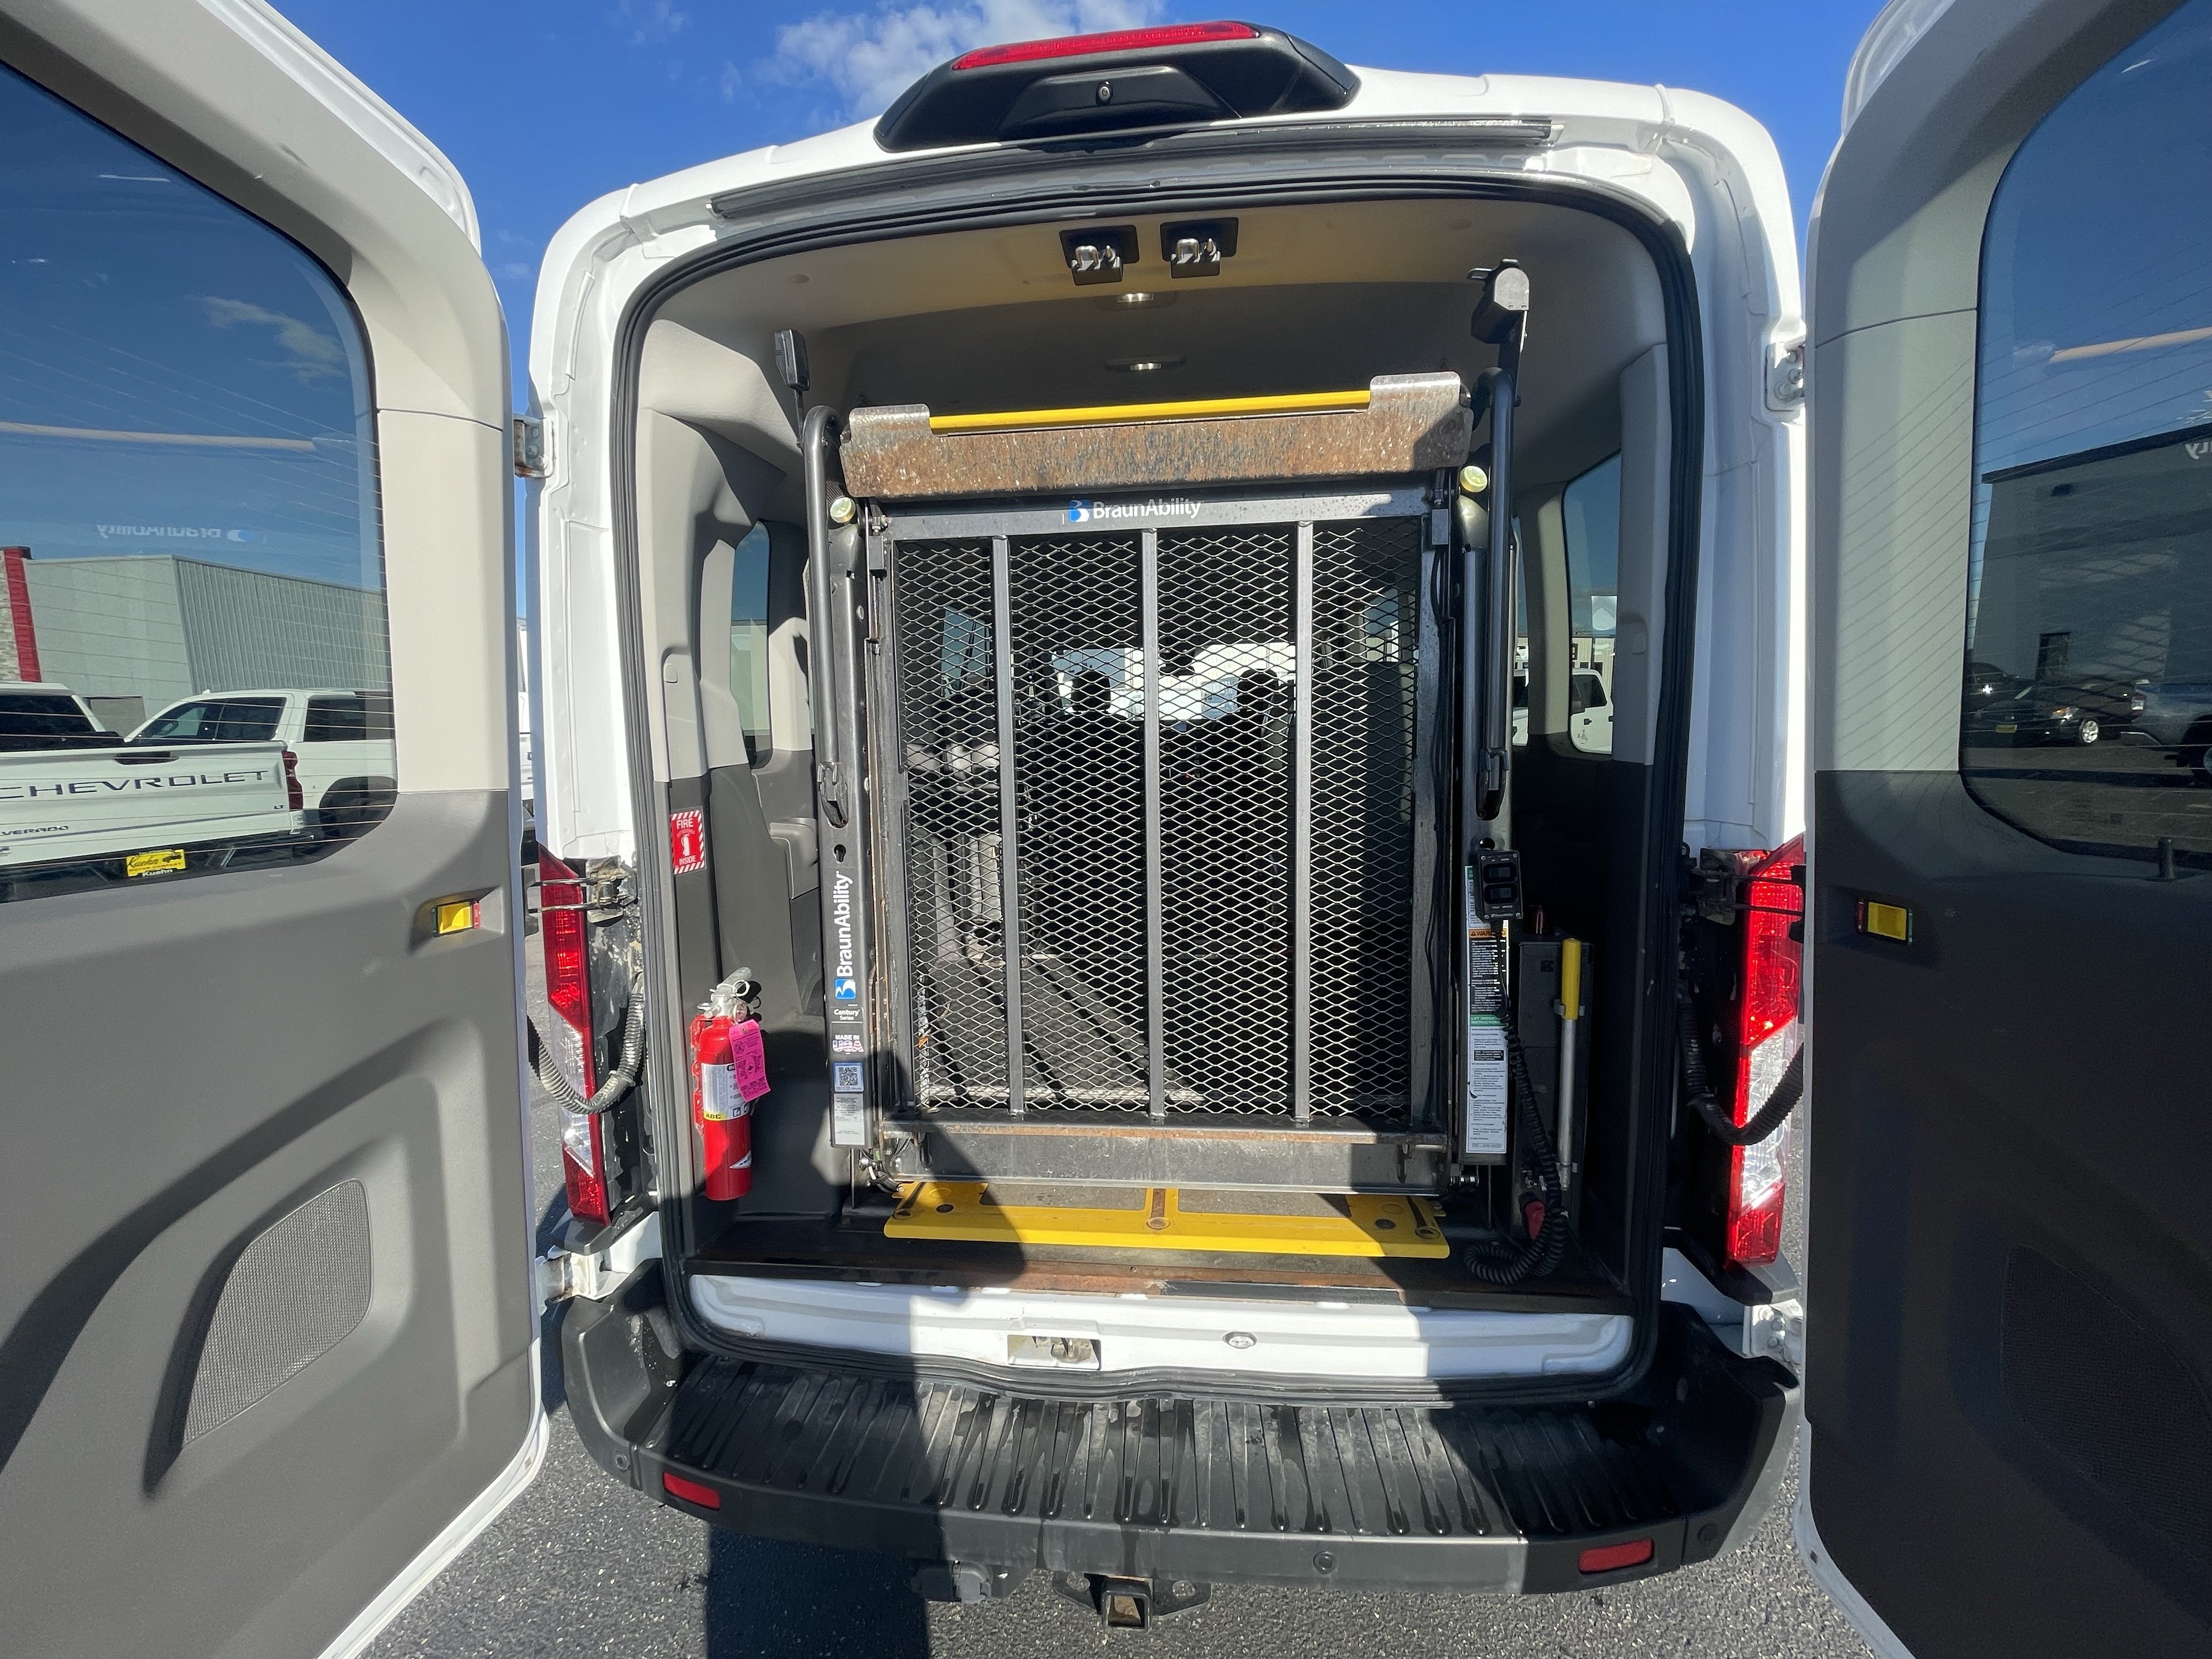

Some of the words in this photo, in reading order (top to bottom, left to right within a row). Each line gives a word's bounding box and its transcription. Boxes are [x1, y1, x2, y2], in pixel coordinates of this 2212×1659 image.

[1093, 498, 1201, 518] BraunAbility
[0, 770, 269, 799] CHEVROLET
[676, 818, 693, 830] FIRE
[128, 856, 159, 868] Kuehn
[679, 855, 696, 865] INSIDE
[833, 873, 854, 977] BraunAbility
[833, 1040, 864, 1052] USA
